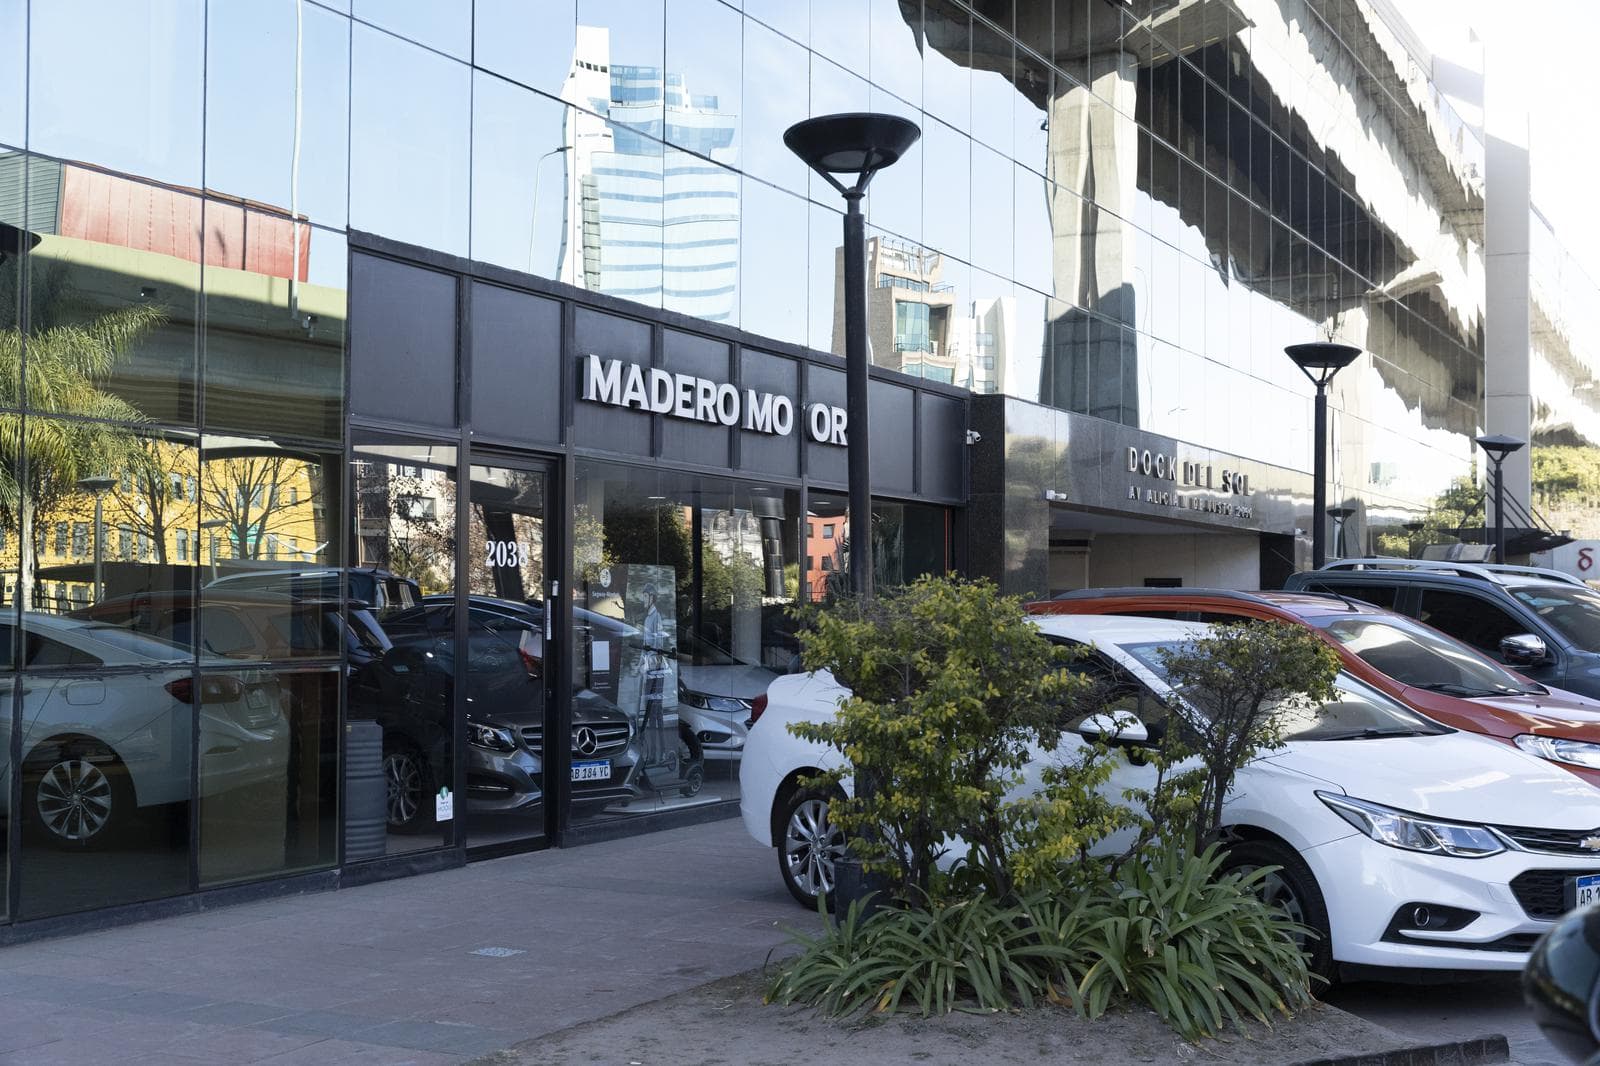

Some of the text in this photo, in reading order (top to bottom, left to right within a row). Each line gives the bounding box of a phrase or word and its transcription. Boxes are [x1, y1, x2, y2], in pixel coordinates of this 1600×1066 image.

[583, 354, 740, 426] MADERO
[1128, 447, 1176, 480] DOCK
[1146, 490, 1178, 506] ALICIA
[486, 541, 528, 567] 2038
[583, 767, 597, 779] 184
[1580, 888, 1592, 906] AB
